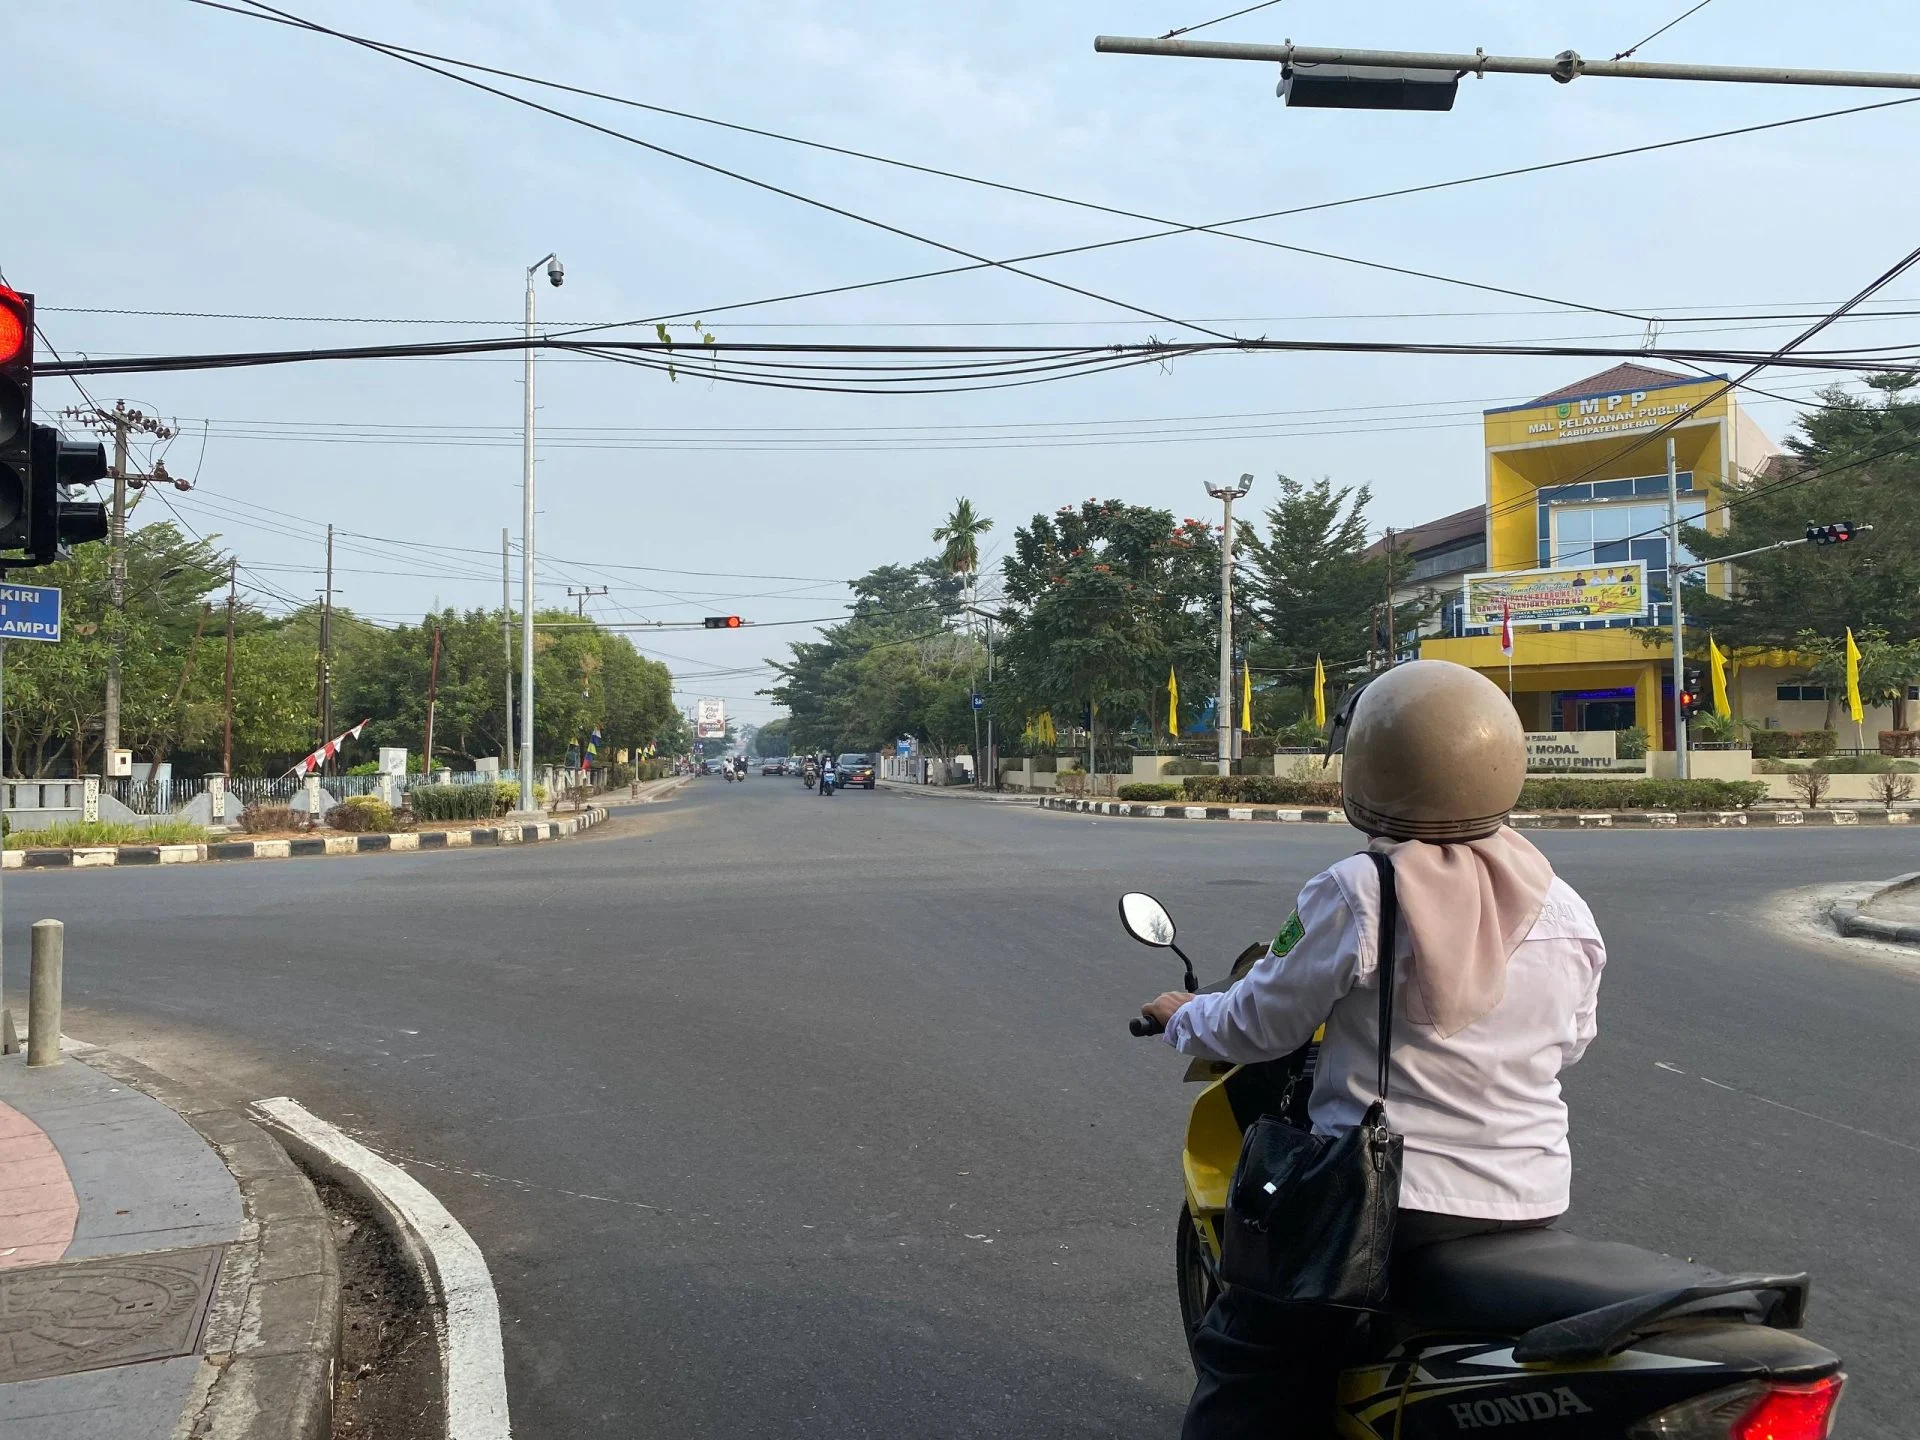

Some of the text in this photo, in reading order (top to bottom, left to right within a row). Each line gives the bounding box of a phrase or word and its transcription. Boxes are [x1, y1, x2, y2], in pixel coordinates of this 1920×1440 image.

[1528, 402, 1690, 434] MAL PELAYANAN PUBLIK
[1559, 418, 1657, 438] KABUPATEN BERAU
[0, 589, 40, 603] KIRI
[0, 620, 58, 635] AMPU
[1536, 744, 1579, 754] MODAL
[1539, 757, 1571, 767] SATU
[1573, 757, 1612, 767] PINTU
[1448, 1386, 1593, 1429] HONDA
